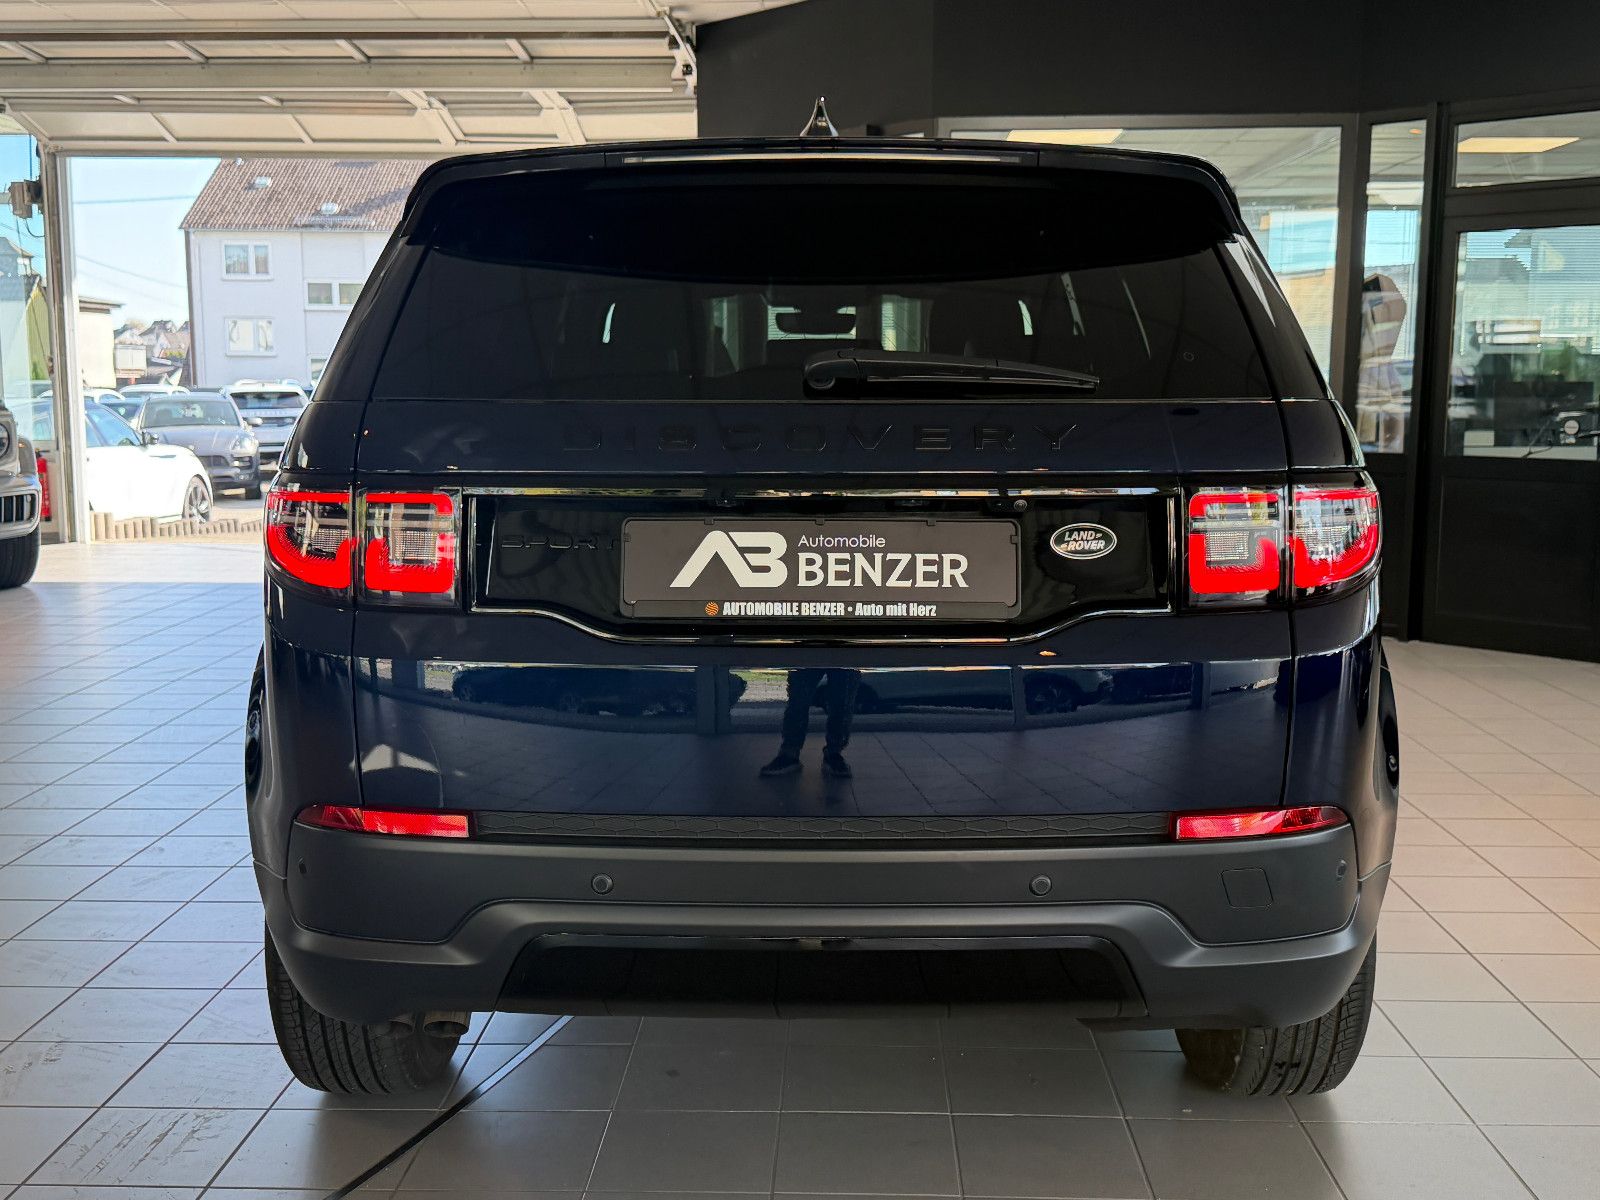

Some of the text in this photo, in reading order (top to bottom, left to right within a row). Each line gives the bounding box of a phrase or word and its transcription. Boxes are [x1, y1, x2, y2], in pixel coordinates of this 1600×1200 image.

[562, 423, 1078, 452] DISCOVERY
[797, 534, 886, 549] Automobile
[1064, 530, 1095, 542] LAND
[1067, 540, 1106, 551] ROVER
[797, 552, 969, 588] BENZER
[722, 601, 937, 617] AUTOMOBILE BENZER Auto mit Herz
